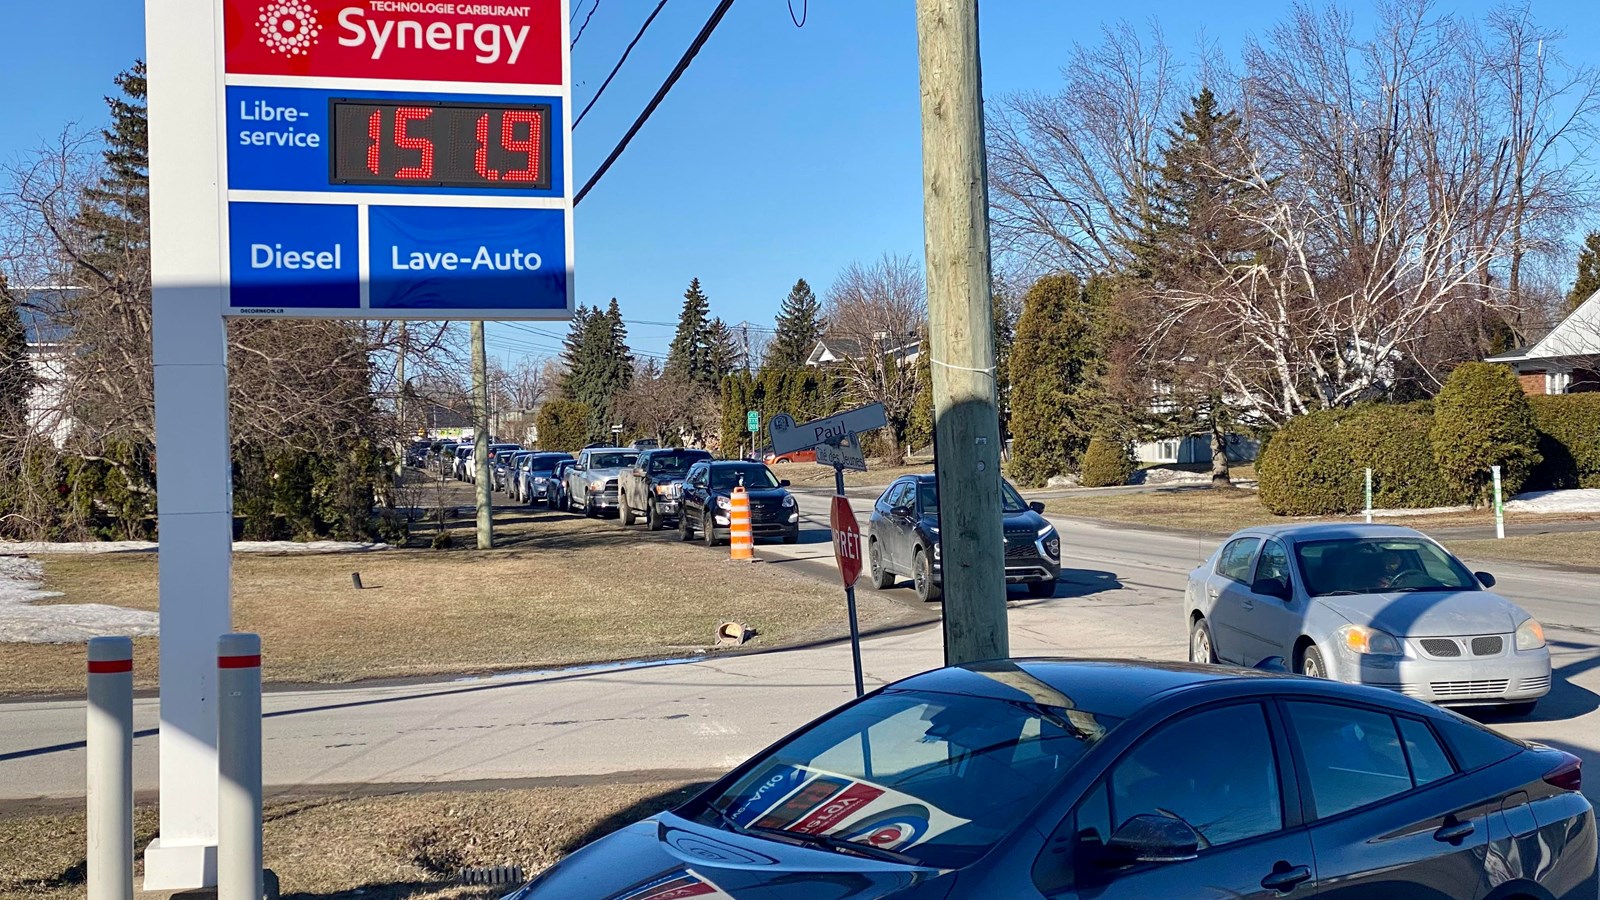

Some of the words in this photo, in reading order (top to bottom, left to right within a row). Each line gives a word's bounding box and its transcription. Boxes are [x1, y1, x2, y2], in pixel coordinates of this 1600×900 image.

[369, 1, 455, 15] TECHNOLOGIE
[456, 4, 531, 17] CARBURANT
[338, 8, 531, 64] Synergy
[240, 100, 309, 122] Libre-
[239, 126, 320, 148] service
[250, 244, 341, 270] Diesel
[391, 246, 542, 271] Lave-Auto
[814, 421, 847, 441] Paul
[829, 448, 841, 464] des
